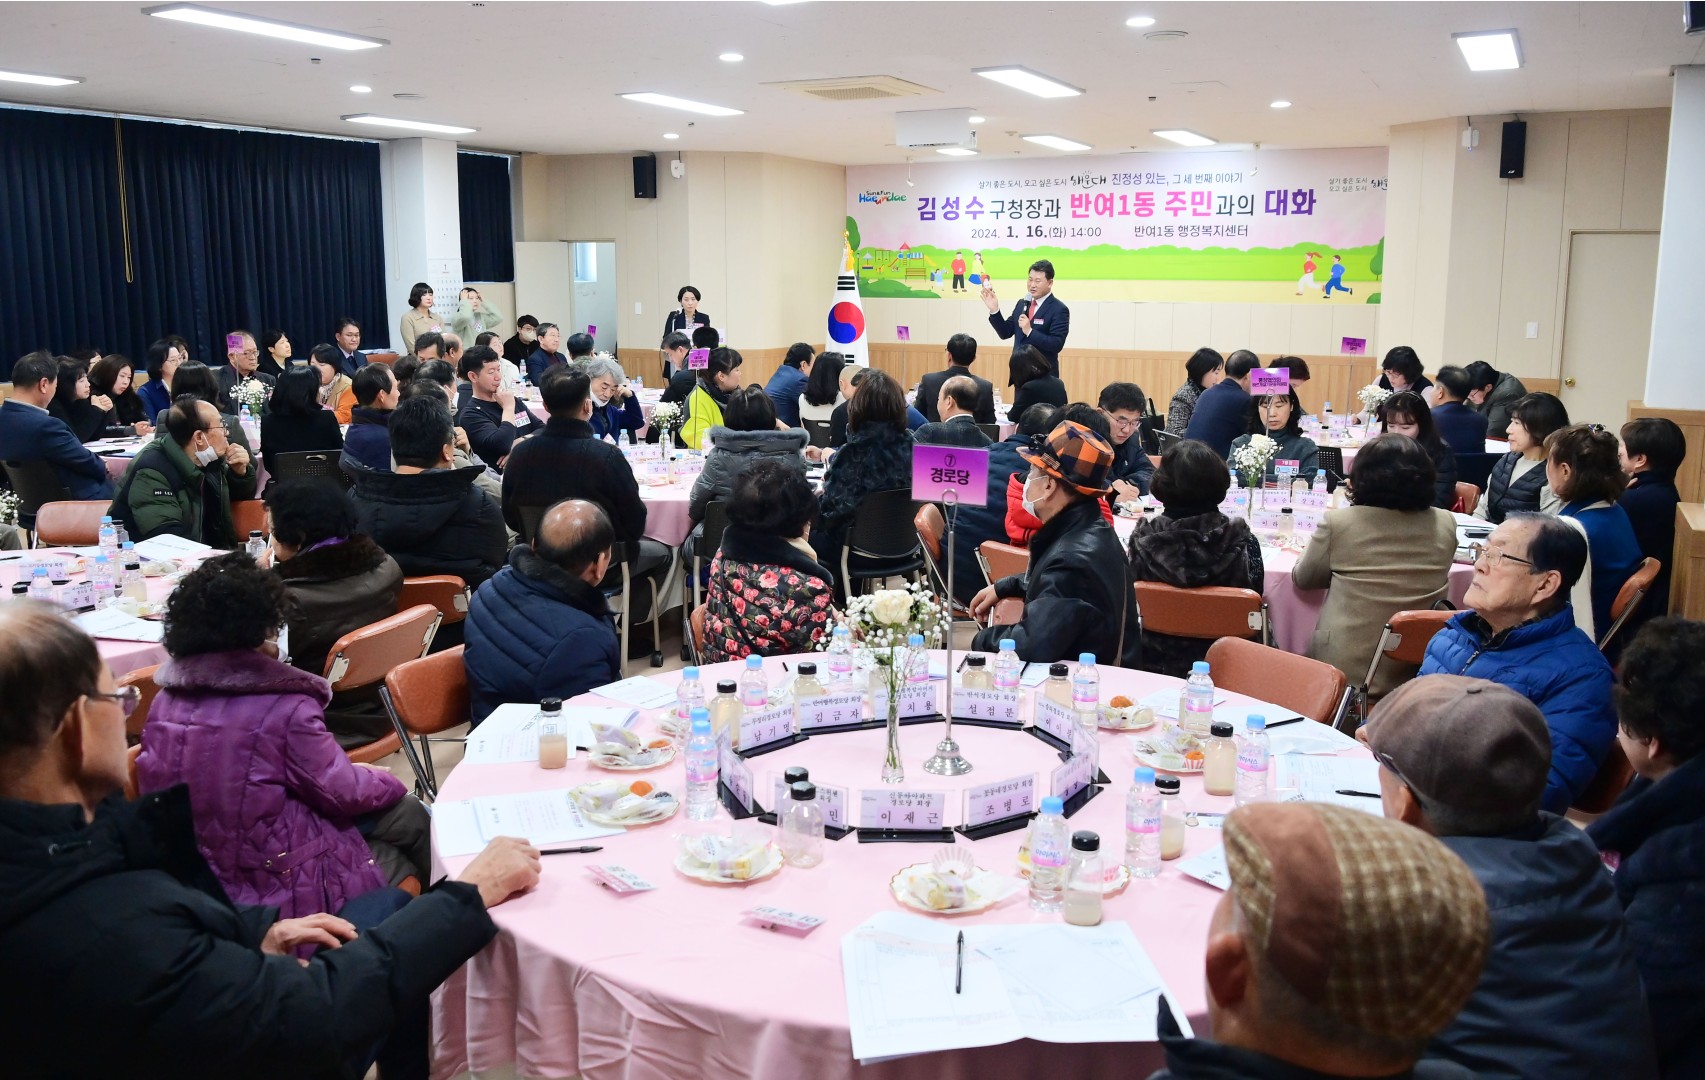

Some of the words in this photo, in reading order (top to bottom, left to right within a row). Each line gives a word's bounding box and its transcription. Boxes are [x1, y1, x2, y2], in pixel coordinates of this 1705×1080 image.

[979, 180, 992, 189] 살기
[994, 180, 1005, 189] 좋은
[1024, 179, 1037, 187] 오고
[1040, 179, 1051, 187] 싶은
[1054, 178, 1067, 186] 도시
[1070, 173, 1106, 189] 해운대
[1112, 173, 1142, 185] 진정성
[1172, 174, 1181, 184] 그
[1184, 174, 1192, 184] 세
[1195, 173, 1212, 183] 번째
[1215, 172, 1243, 183] 이야기
[858, 192, 907, 204] Haeundae
[1070, 191, 1155, 218] 반여1동
[1264, 189, 1317, 216] 대화
[971, 229, 1000, 239] 2024.
[1071, 227, 1102, 237] 14:00
[1134, 225, 1175, 237] 반여1동
[1178, 225, 1248, 237] 행정복지센터
[931, 467, 970, 486] 경로당
